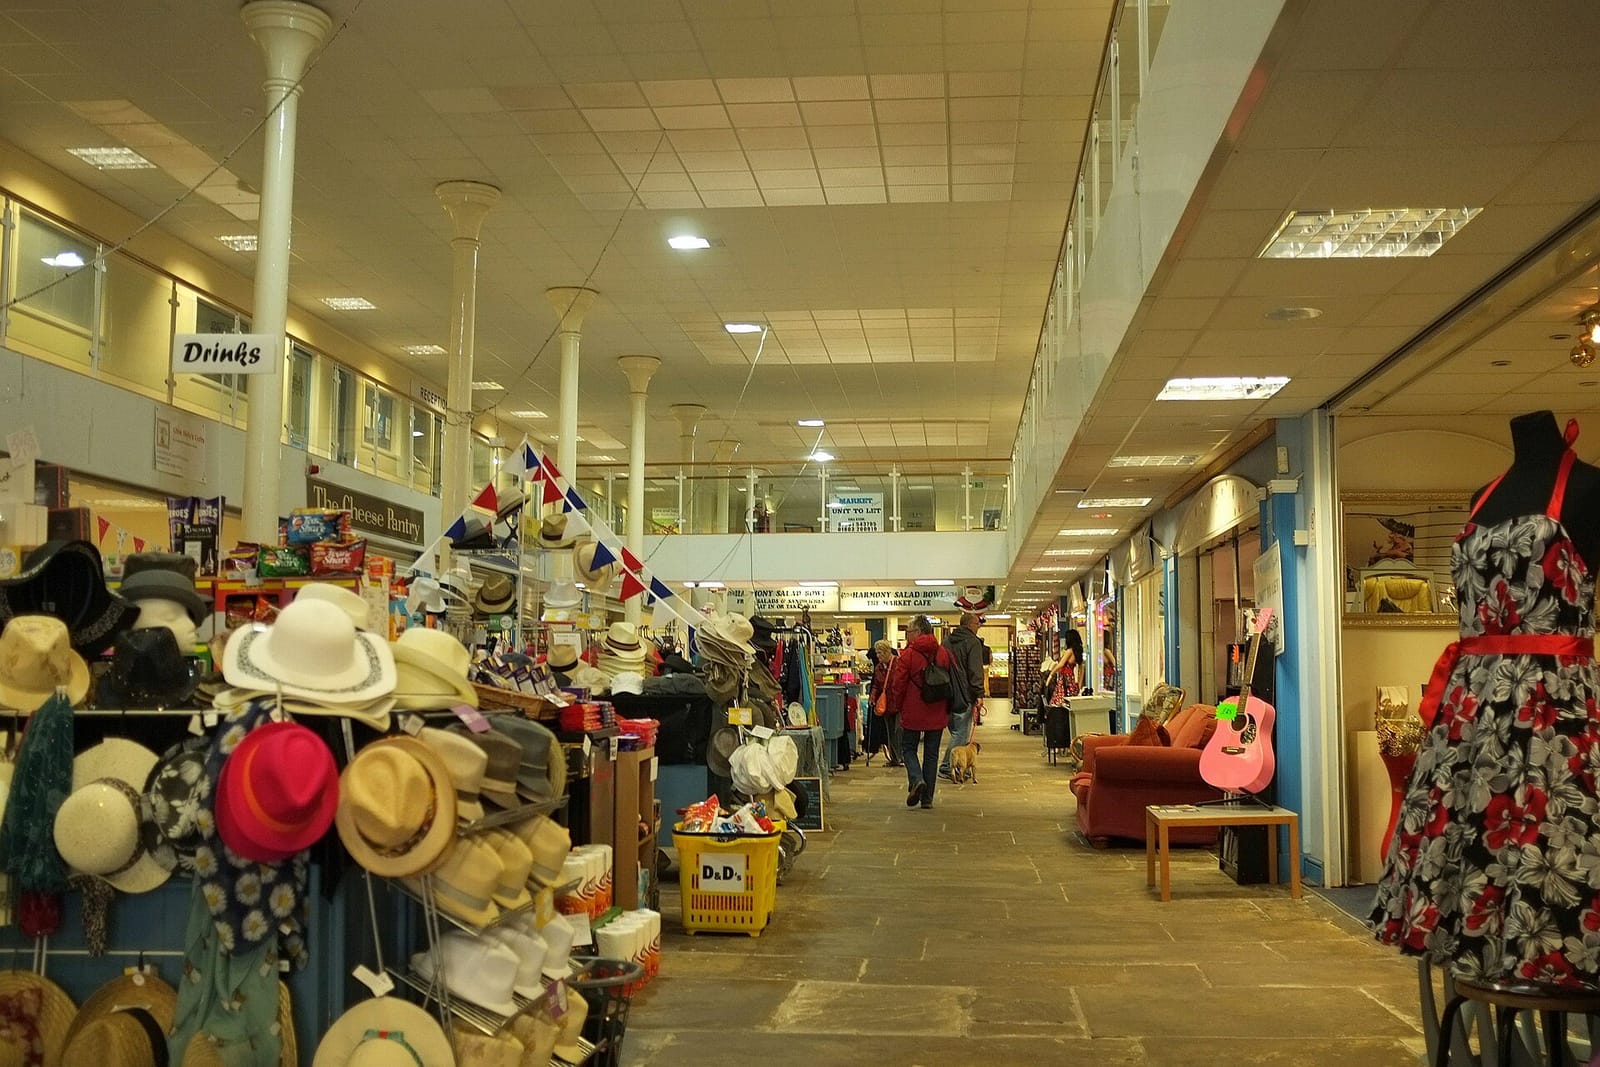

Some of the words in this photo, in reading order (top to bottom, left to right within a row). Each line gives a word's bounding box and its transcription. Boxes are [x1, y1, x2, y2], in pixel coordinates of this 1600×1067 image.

[183, 342, 261, 367] Drinks
[420, 386, 448, 410] RECEPTIO
[313, 485, 339, 511] The
[342, 494, 385, 527] Cheese
[387, 507, 421, 542] Pantry
[702, 865, 742, 881] D&D's
